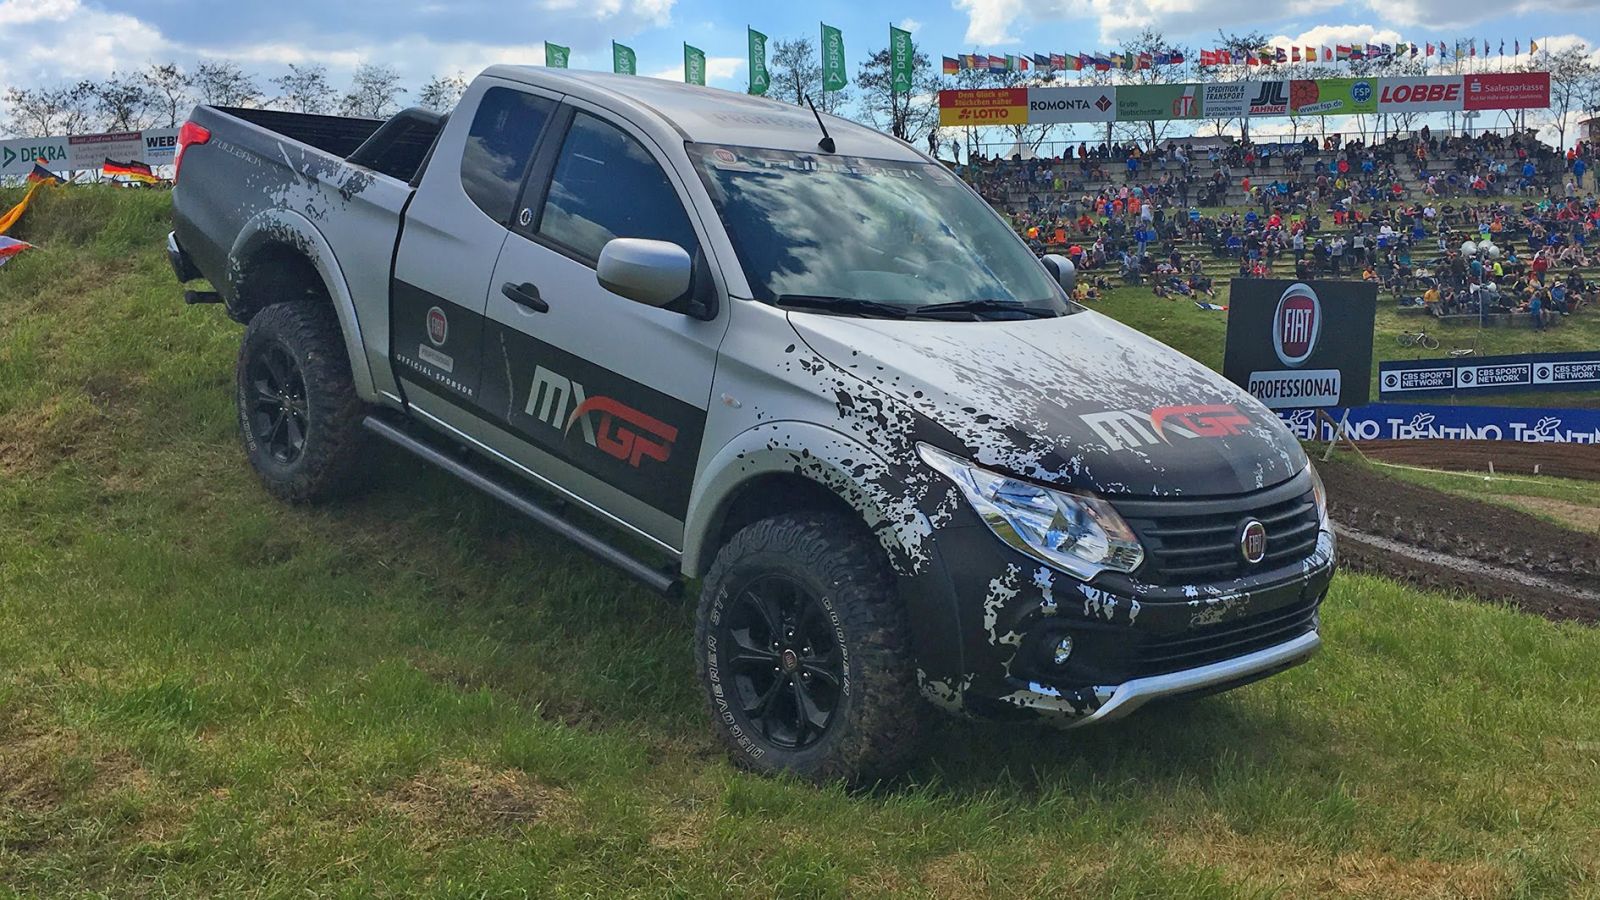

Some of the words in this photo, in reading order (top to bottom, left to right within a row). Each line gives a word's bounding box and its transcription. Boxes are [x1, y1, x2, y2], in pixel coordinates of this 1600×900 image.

[754, 37, 764, 72] DEKRA
[830, 33, 839, 69] DEKRA
[897, 34, 906, 69] DEKRA
[1207, 85, 1239, 93] SPEDITION
[1354, 87, 1371, 97] FSP
[1380, 83, 1462, 103] LOBBE
[1485, 84, 1544, 93] Saalesparkasse
[1206, 92, 1245, 100] TRANSPORT
[1030, 100, 1091, 111] ROMONTA
[1173, 96, 1198, 117] GTS
[1249, 105, 1287, 113] JAHNKE
[974, 108, 1009, 119] LOTTO
[21, 145, 67, 162] DEKRA
[1283, 308, 1312, 343] FIAT
[397, 353, 432, 376] OFFICIAL
[436, 373, 473, 396] SPONSOR
[1420, 371, 1452, 380] SPORTS
[1495, 367, 1528, 376] SPORTS
[1554, 365, 1570, 373] CBS
[1554, 371, 1595, 380] NETWORK
[1402, 379, 1444, 387] NETWORK
[1478, 374, 1520, 383] NETWORK
[1250, 377, 1338, 399] PROFESSIONAL
[1249, 533, 1263, 553] FIAT
[710, 583, 729, 626] STT
[821, 595, 851, 697] COOPER
[706, 635, 766, 760] DISCOVERER
